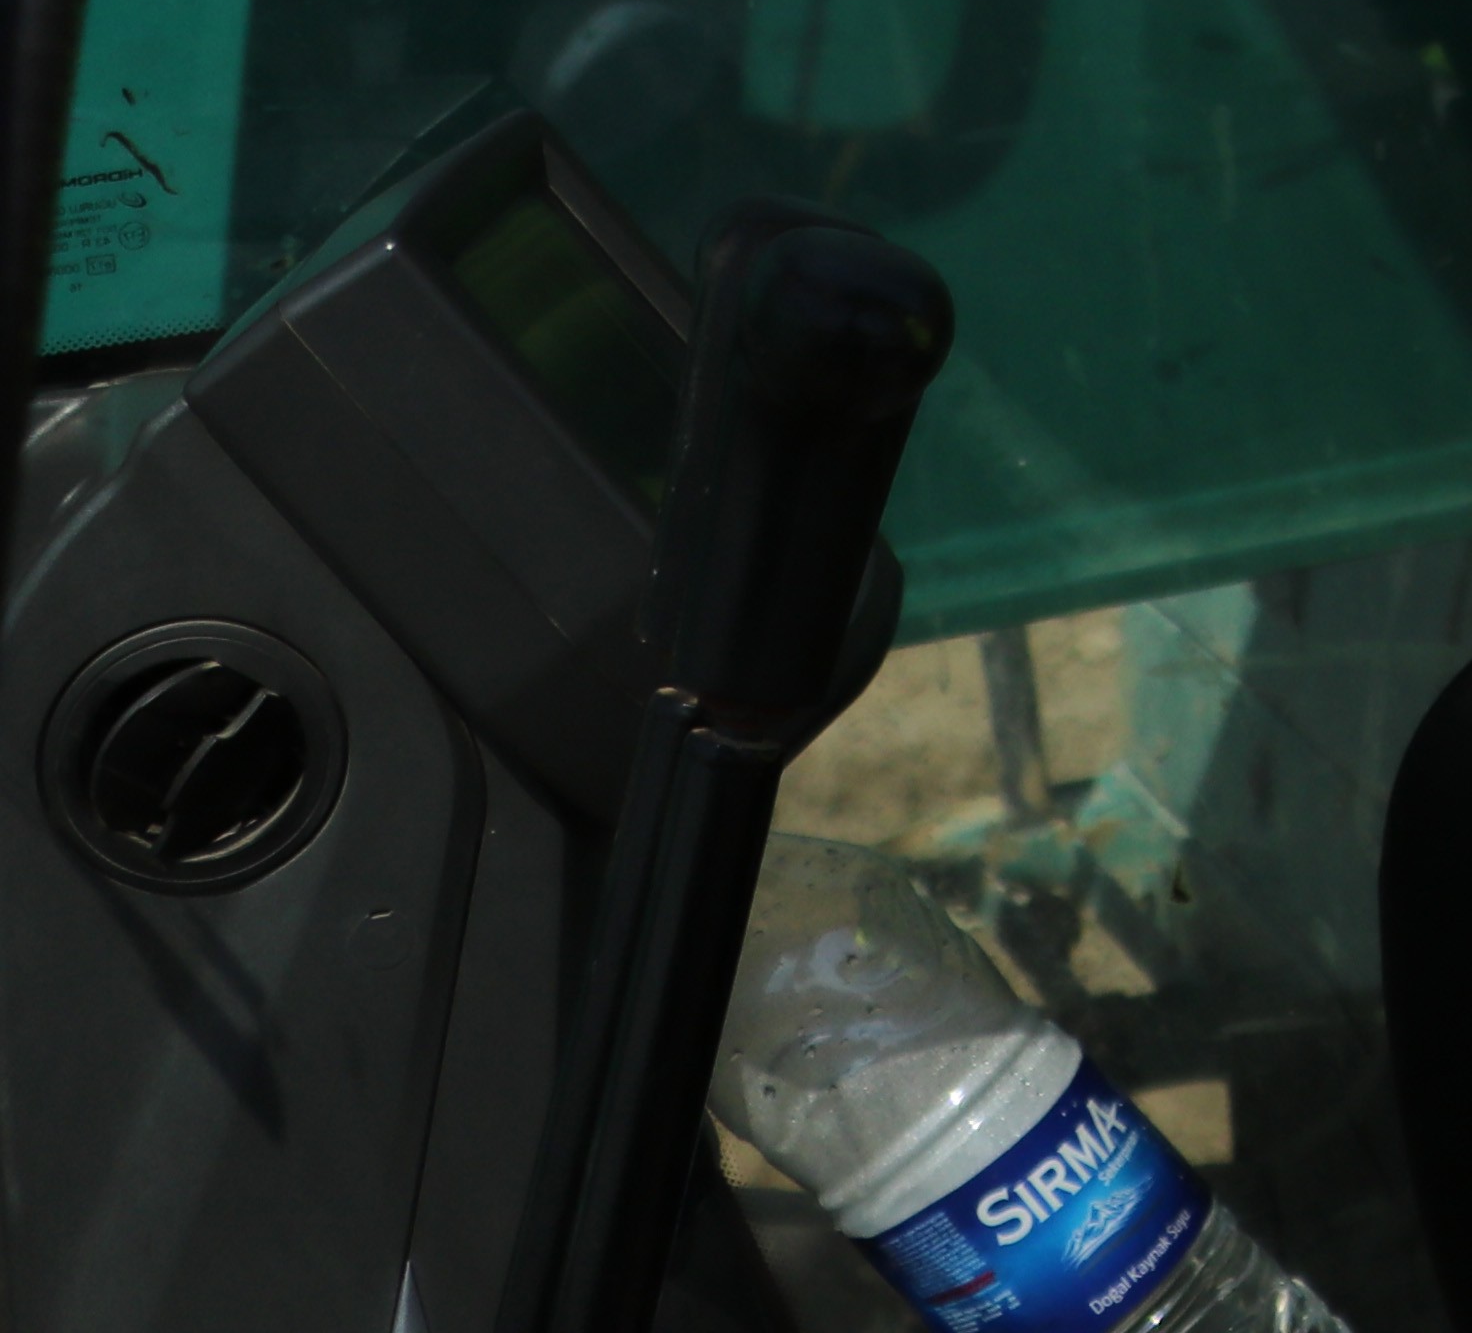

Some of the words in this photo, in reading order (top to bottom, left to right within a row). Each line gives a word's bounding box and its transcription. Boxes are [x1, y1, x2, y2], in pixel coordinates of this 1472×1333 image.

[976, 1097, 1127, 1246] SIRMA
[1126, 1236, 1172, 1283] Kaynak
[1166, 1209, 1191, 1239] Suyu
